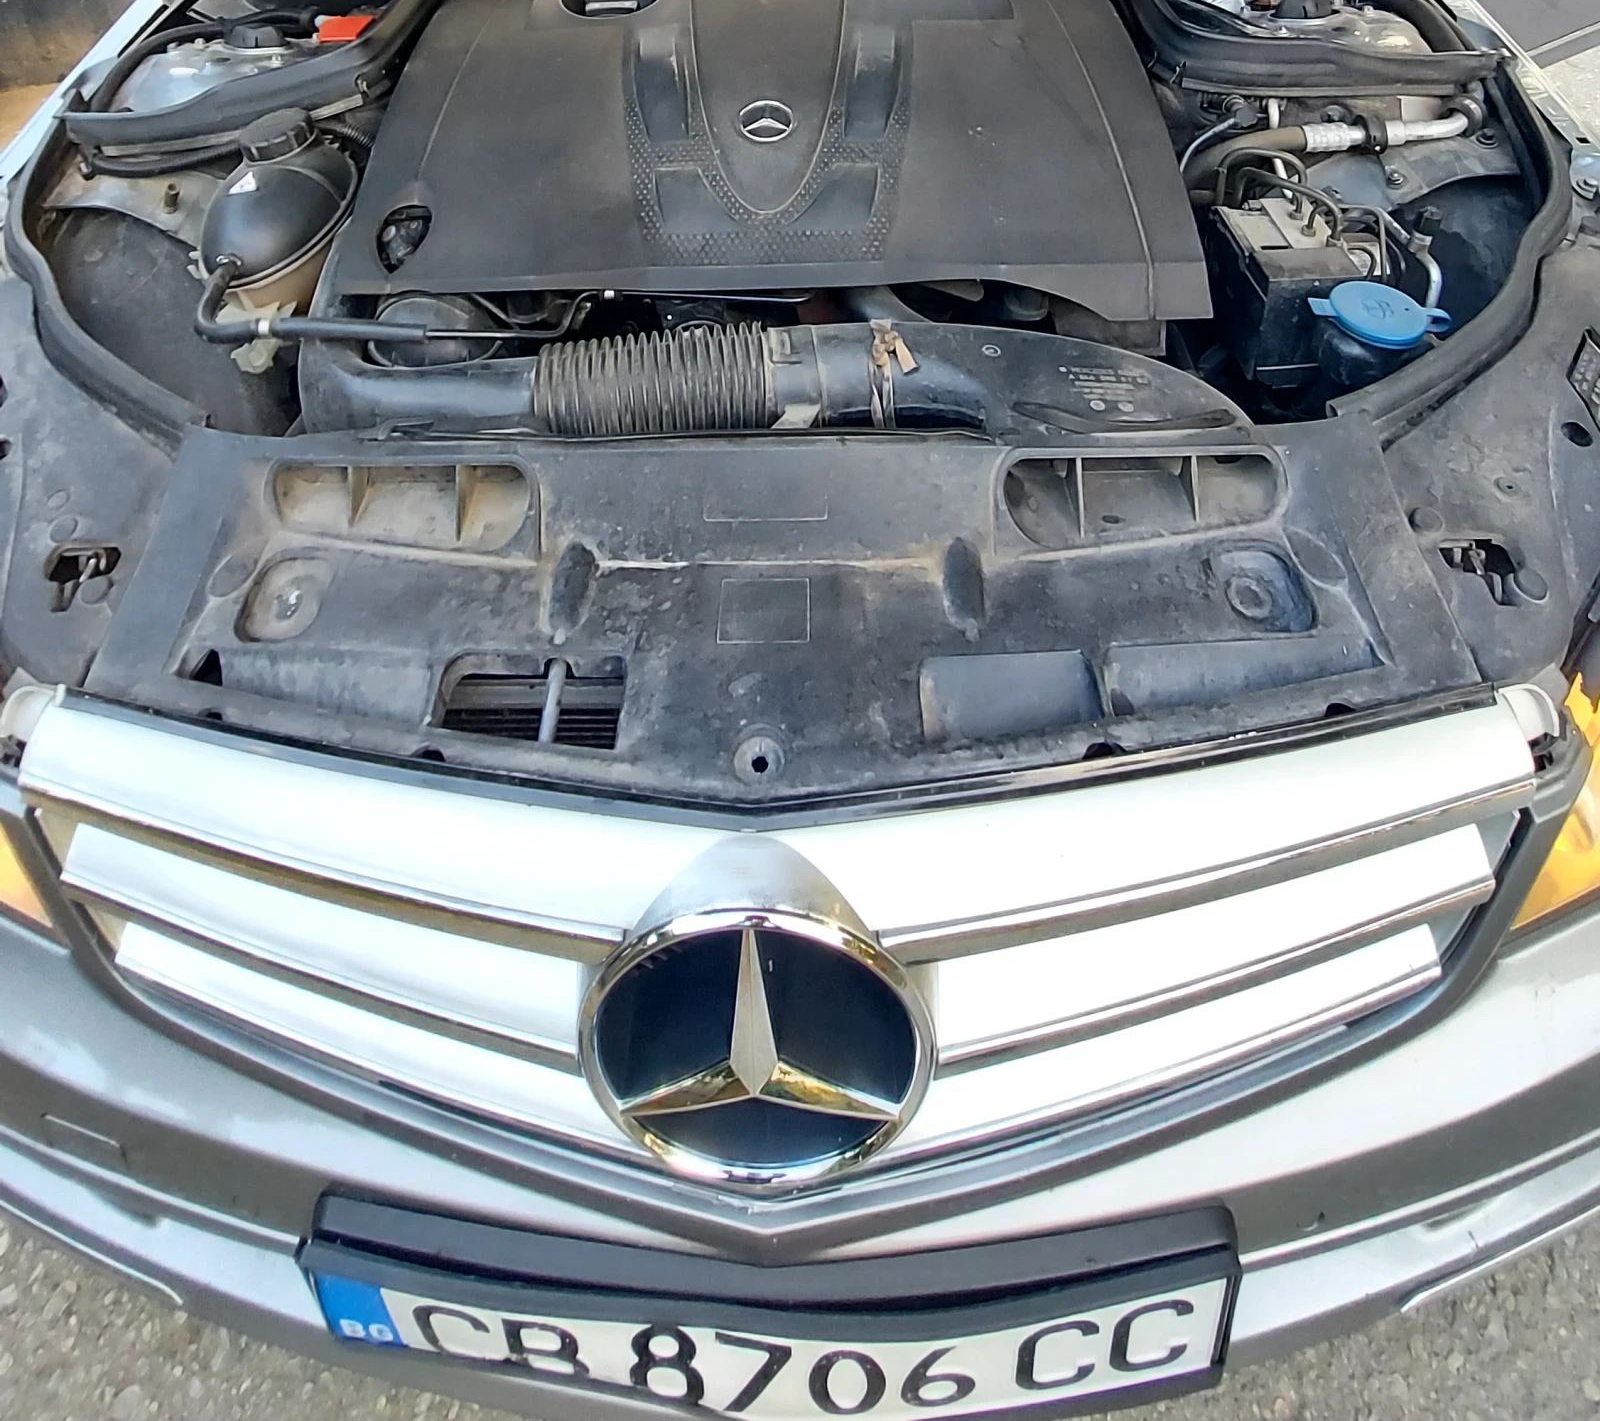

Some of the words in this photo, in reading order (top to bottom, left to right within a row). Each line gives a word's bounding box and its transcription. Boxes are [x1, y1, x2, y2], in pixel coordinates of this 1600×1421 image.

[339, 1318, 394, 1342] BG
[412, 1305, 590, 1377] CB
[630, 1323, 976, 1414] 8706
[1015, 1299, 1194, 1390] CC
